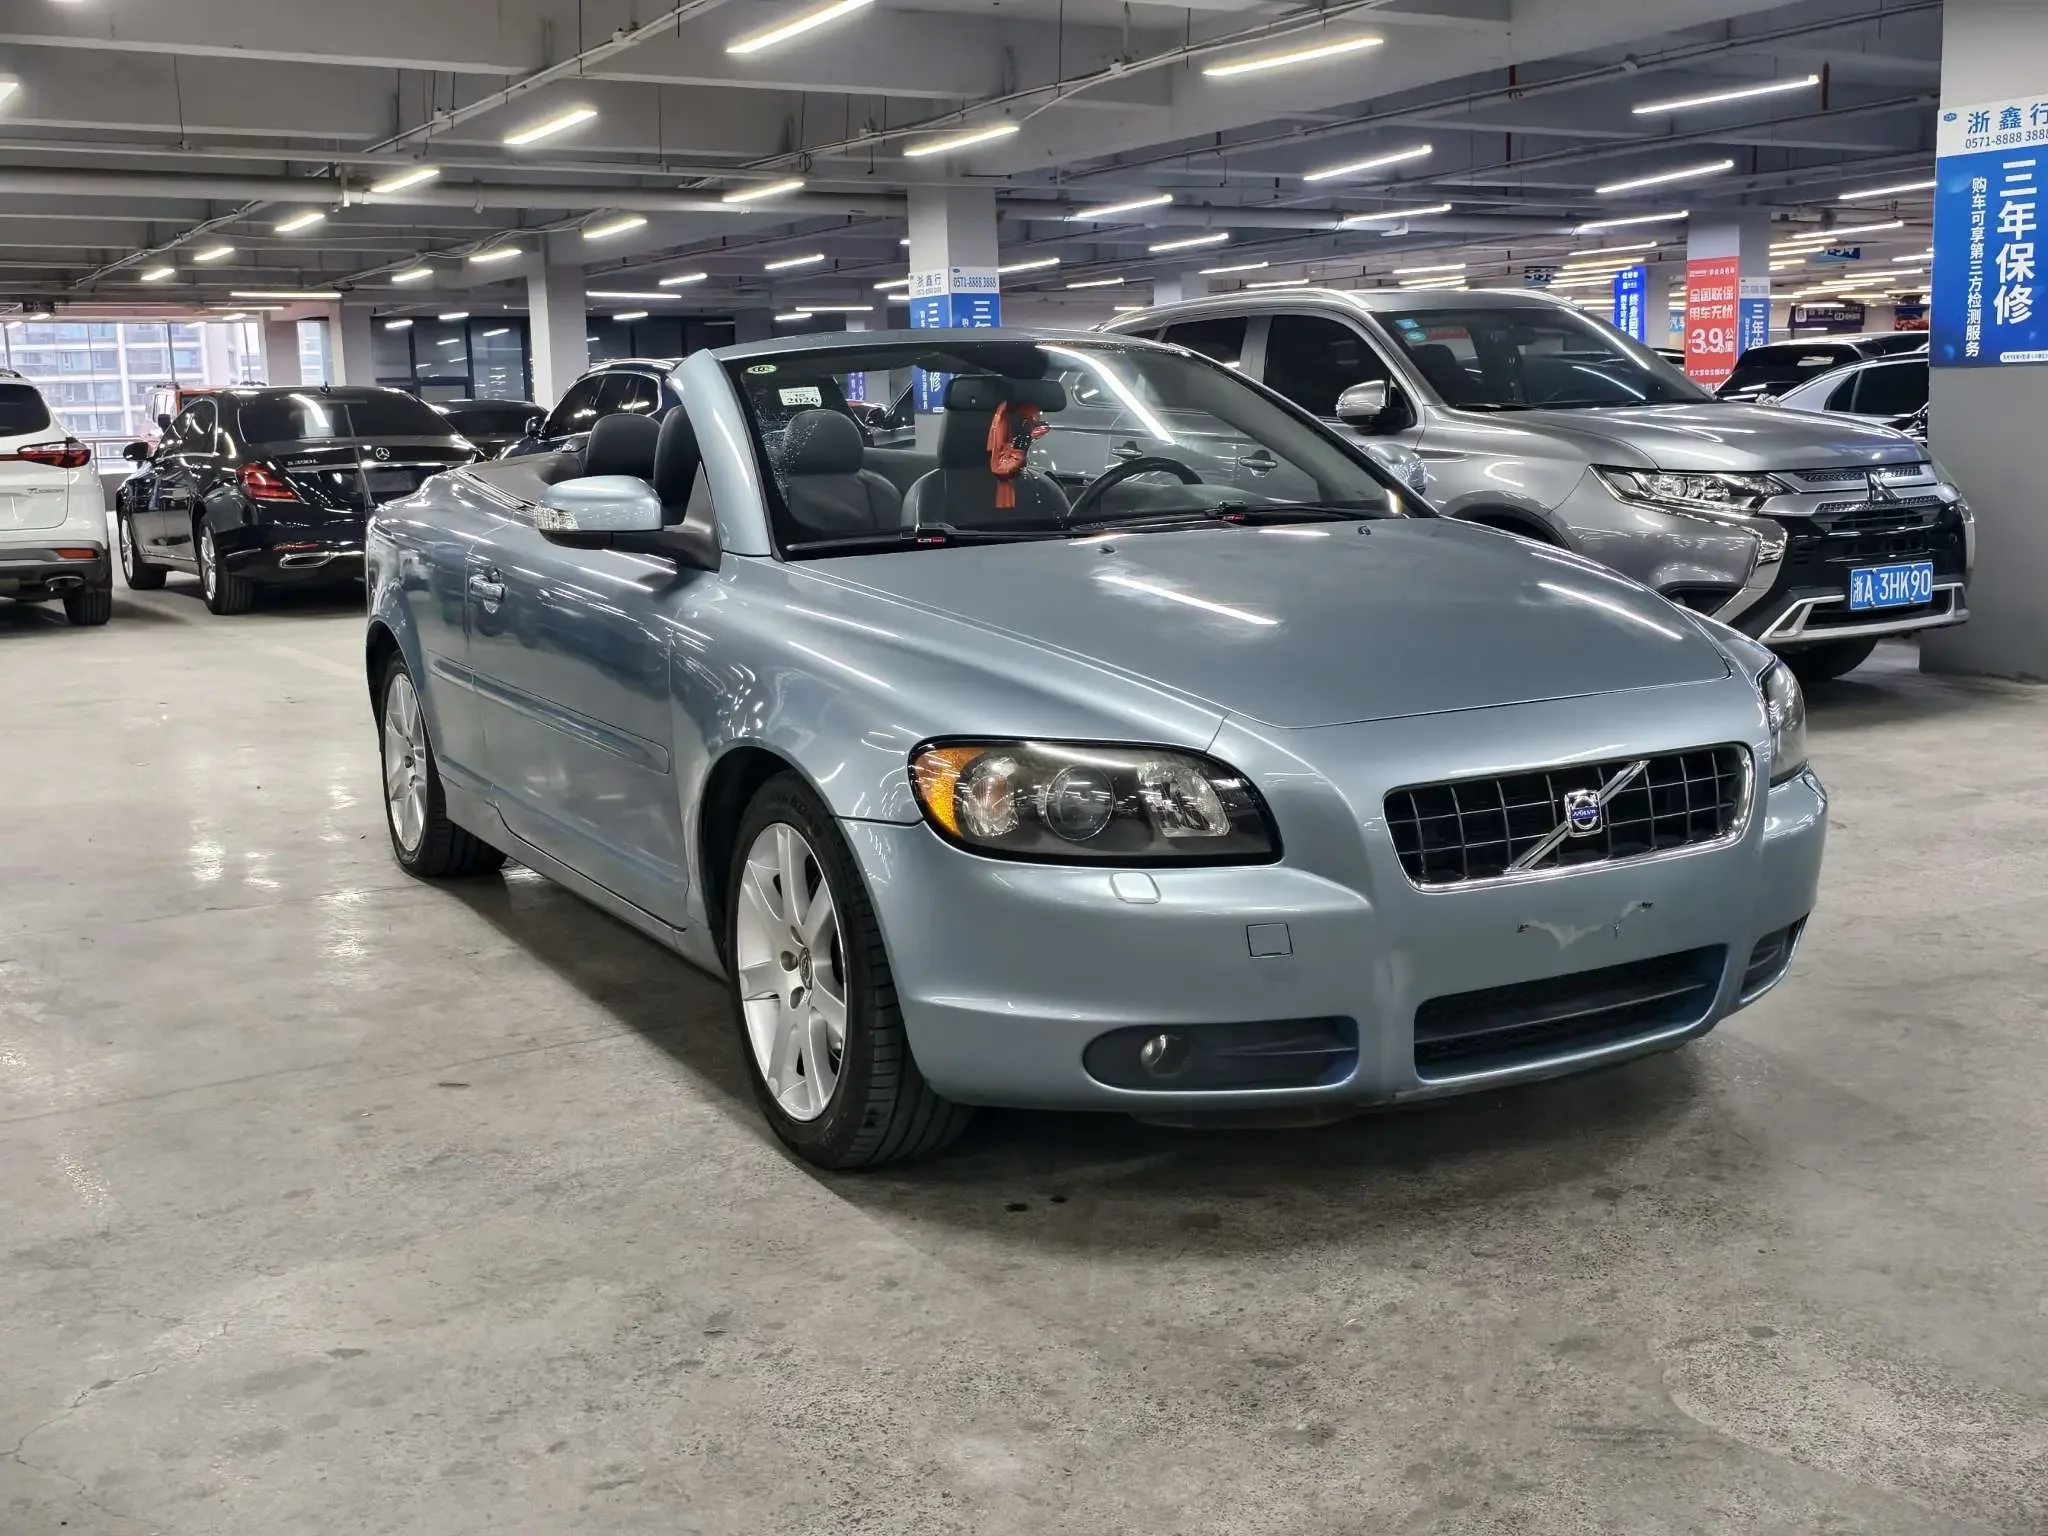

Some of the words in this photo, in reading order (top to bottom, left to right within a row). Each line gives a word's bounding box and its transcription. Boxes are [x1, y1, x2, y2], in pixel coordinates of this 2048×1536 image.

[1965, 132, 2022, 149] 0571-8888
[1967, 103, 2048, 134] 浙鑫行
[1965, 177, 1987, 357] 购车可享第三方检测服务
[1993, 159, 2037, 326] 三年保修
